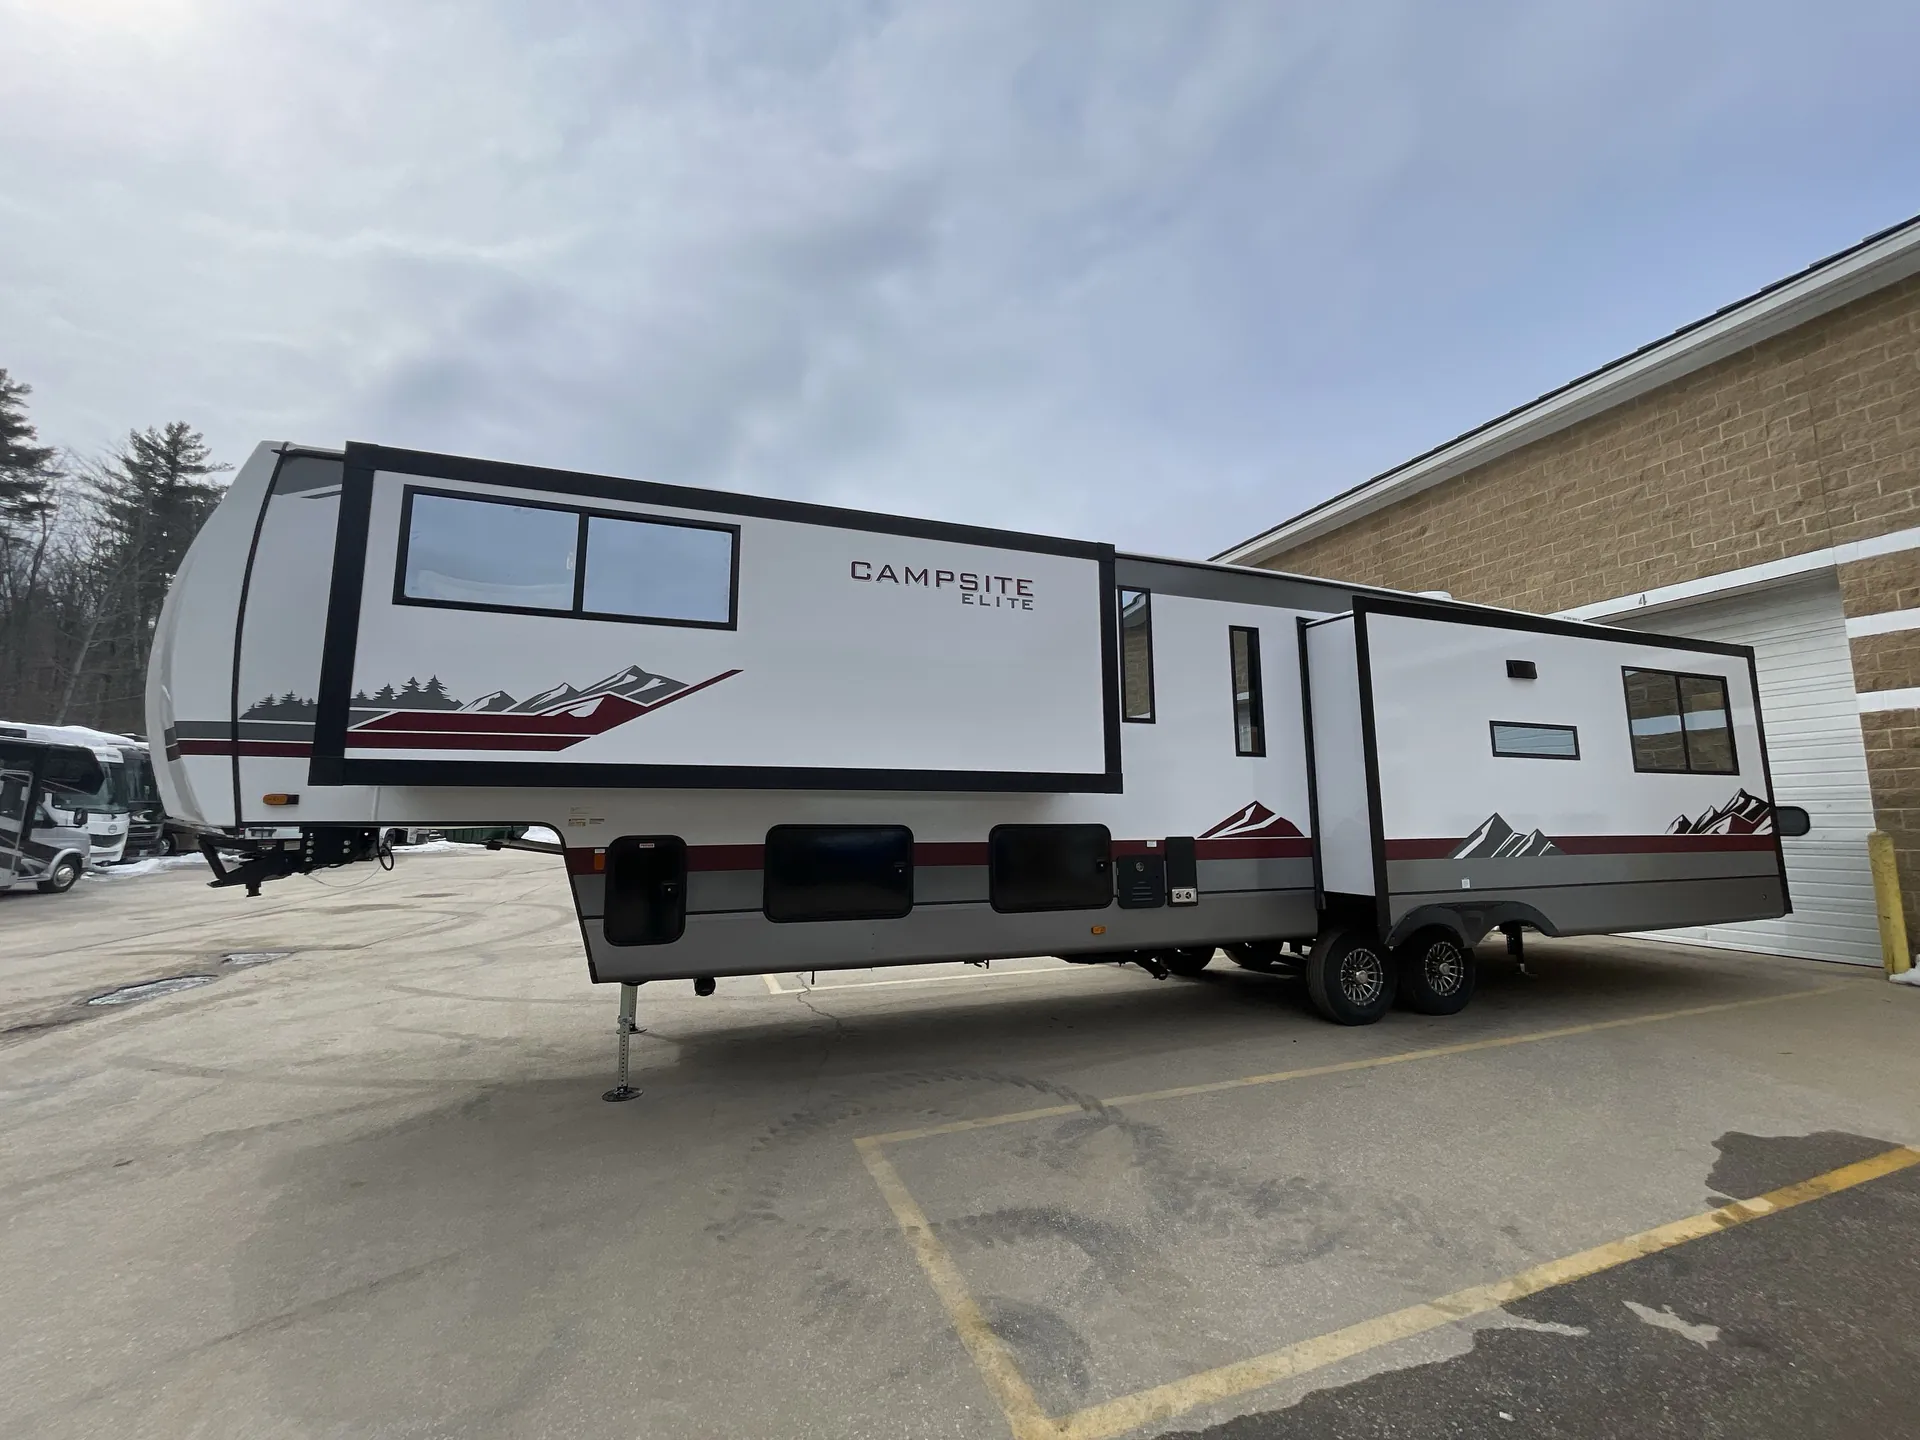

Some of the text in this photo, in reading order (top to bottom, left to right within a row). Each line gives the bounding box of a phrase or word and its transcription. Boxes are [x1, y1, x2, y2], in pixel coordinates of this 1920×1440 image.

[850, 560, 1034, 597] CAMPSITE
[961, 592, 1034, 611] ELITE
[1638, 593, 1647, 605] 4
